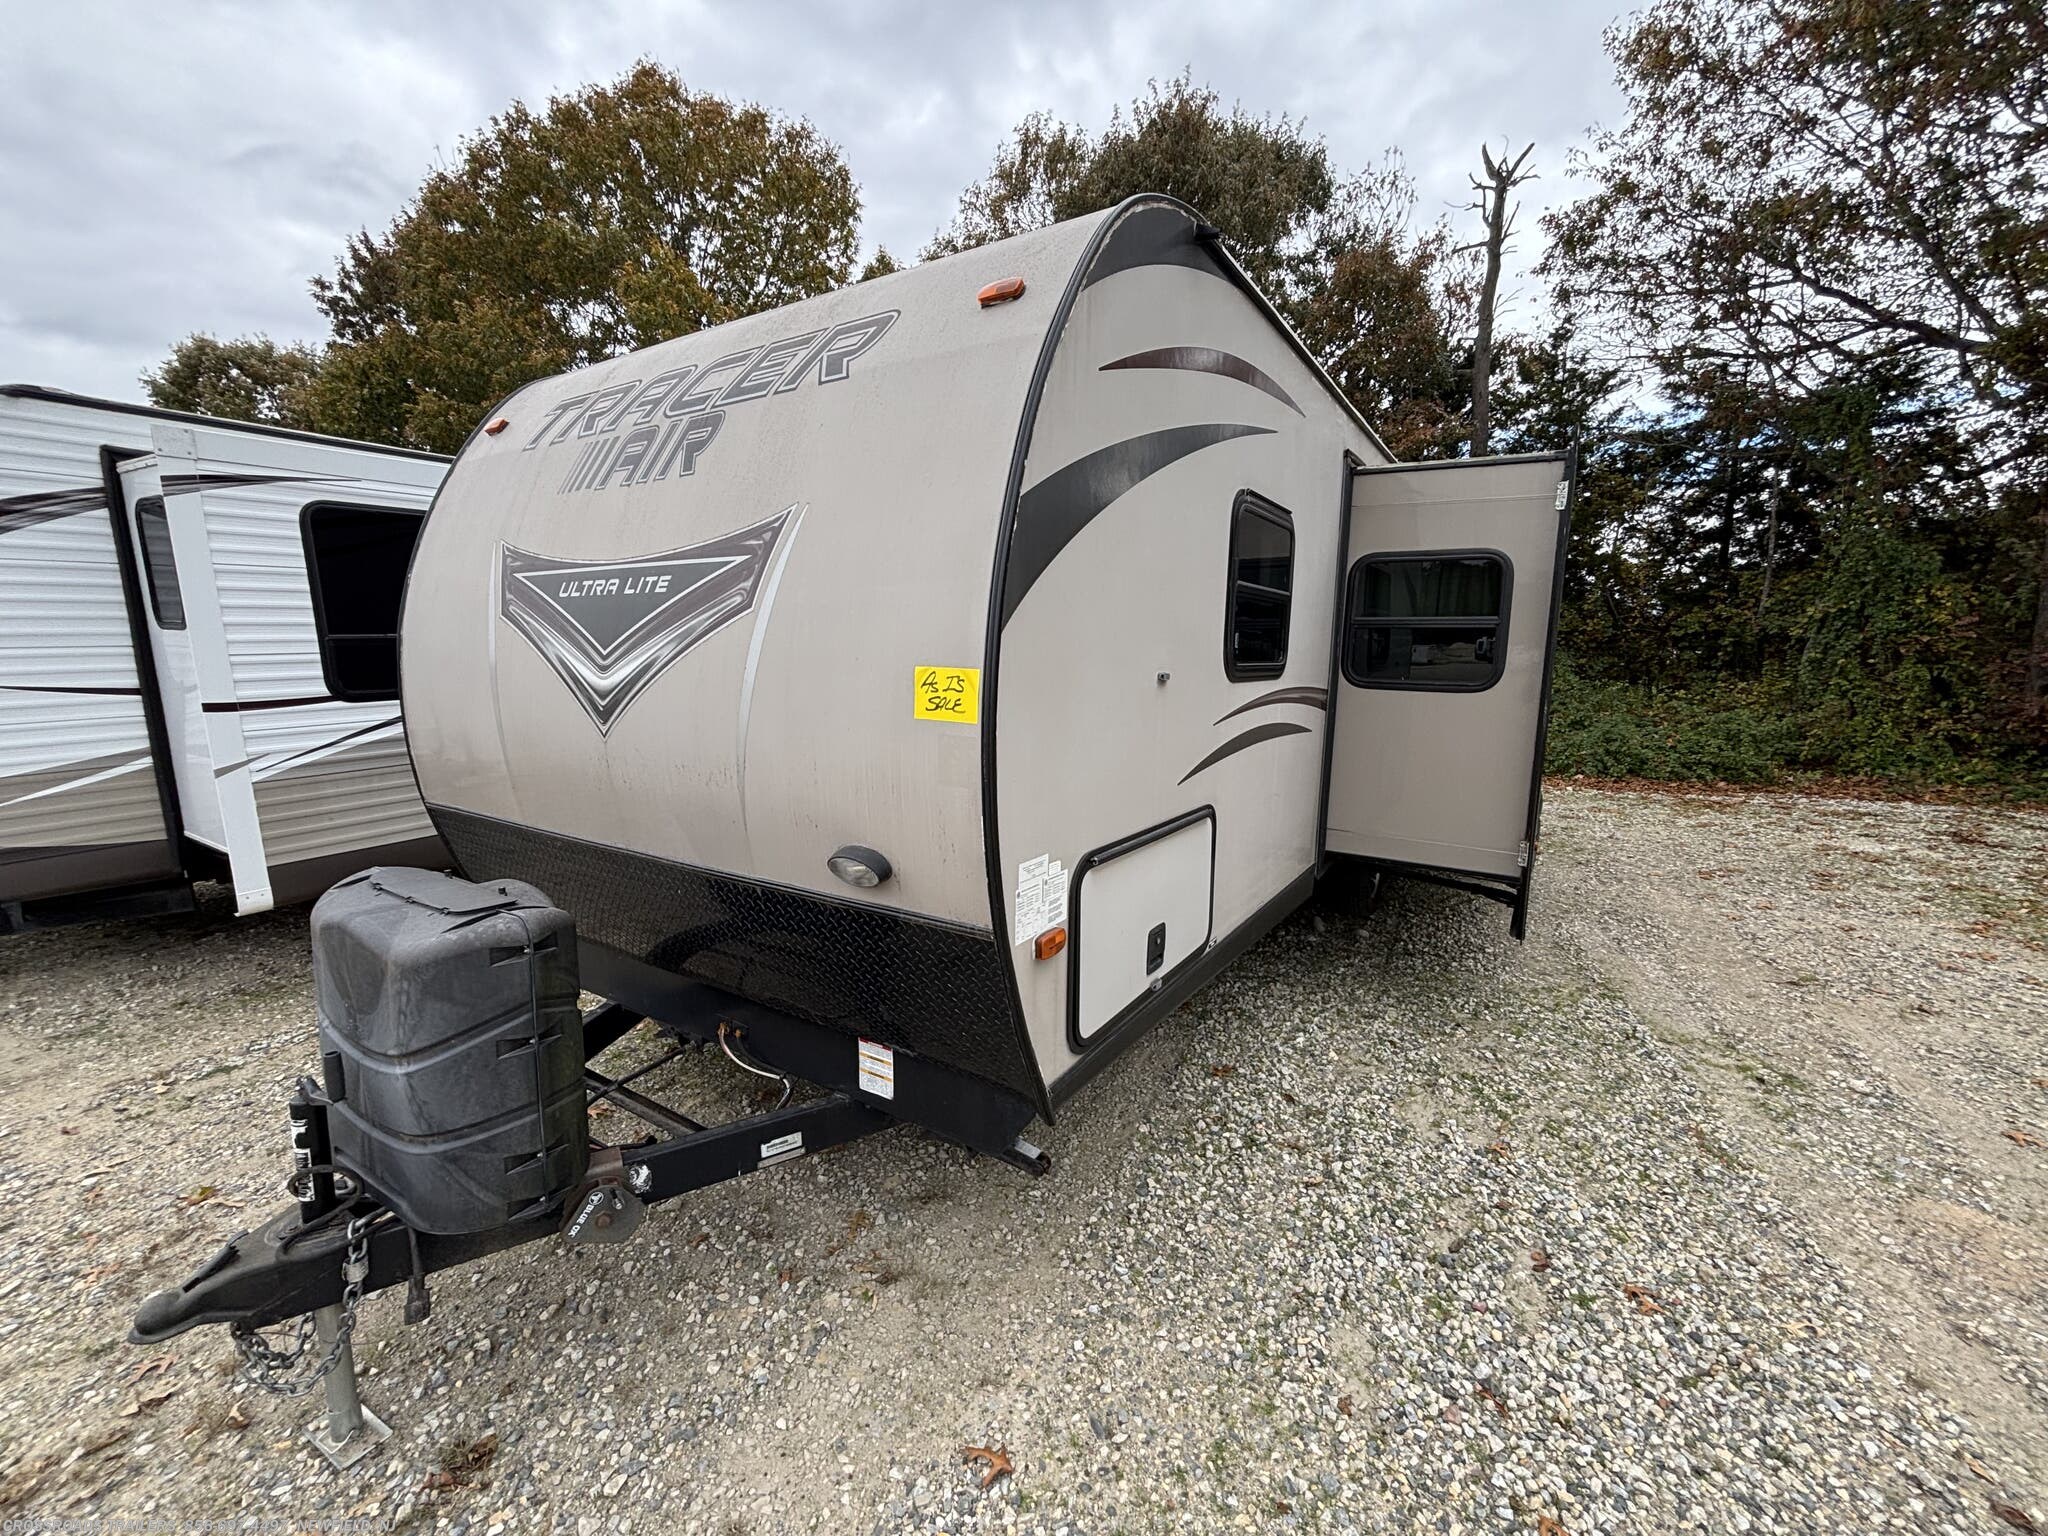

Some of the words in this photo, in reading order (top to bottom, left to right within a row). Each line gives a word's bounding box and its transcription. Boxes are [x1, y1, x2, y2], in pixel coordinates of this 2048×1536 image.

[522, 309, 901, 452] TRACER
[595, 410, 726, 490] AIR
[558, 578, 619, 598] ULTRA
[623, 575, 672, 594] LITE
[942, 675, 965, 693] IS
[925, 696, 966, 714] SALE
[576, 1204, 595, 1224] BLUE
[568, 1224, 581, 1238] OX
